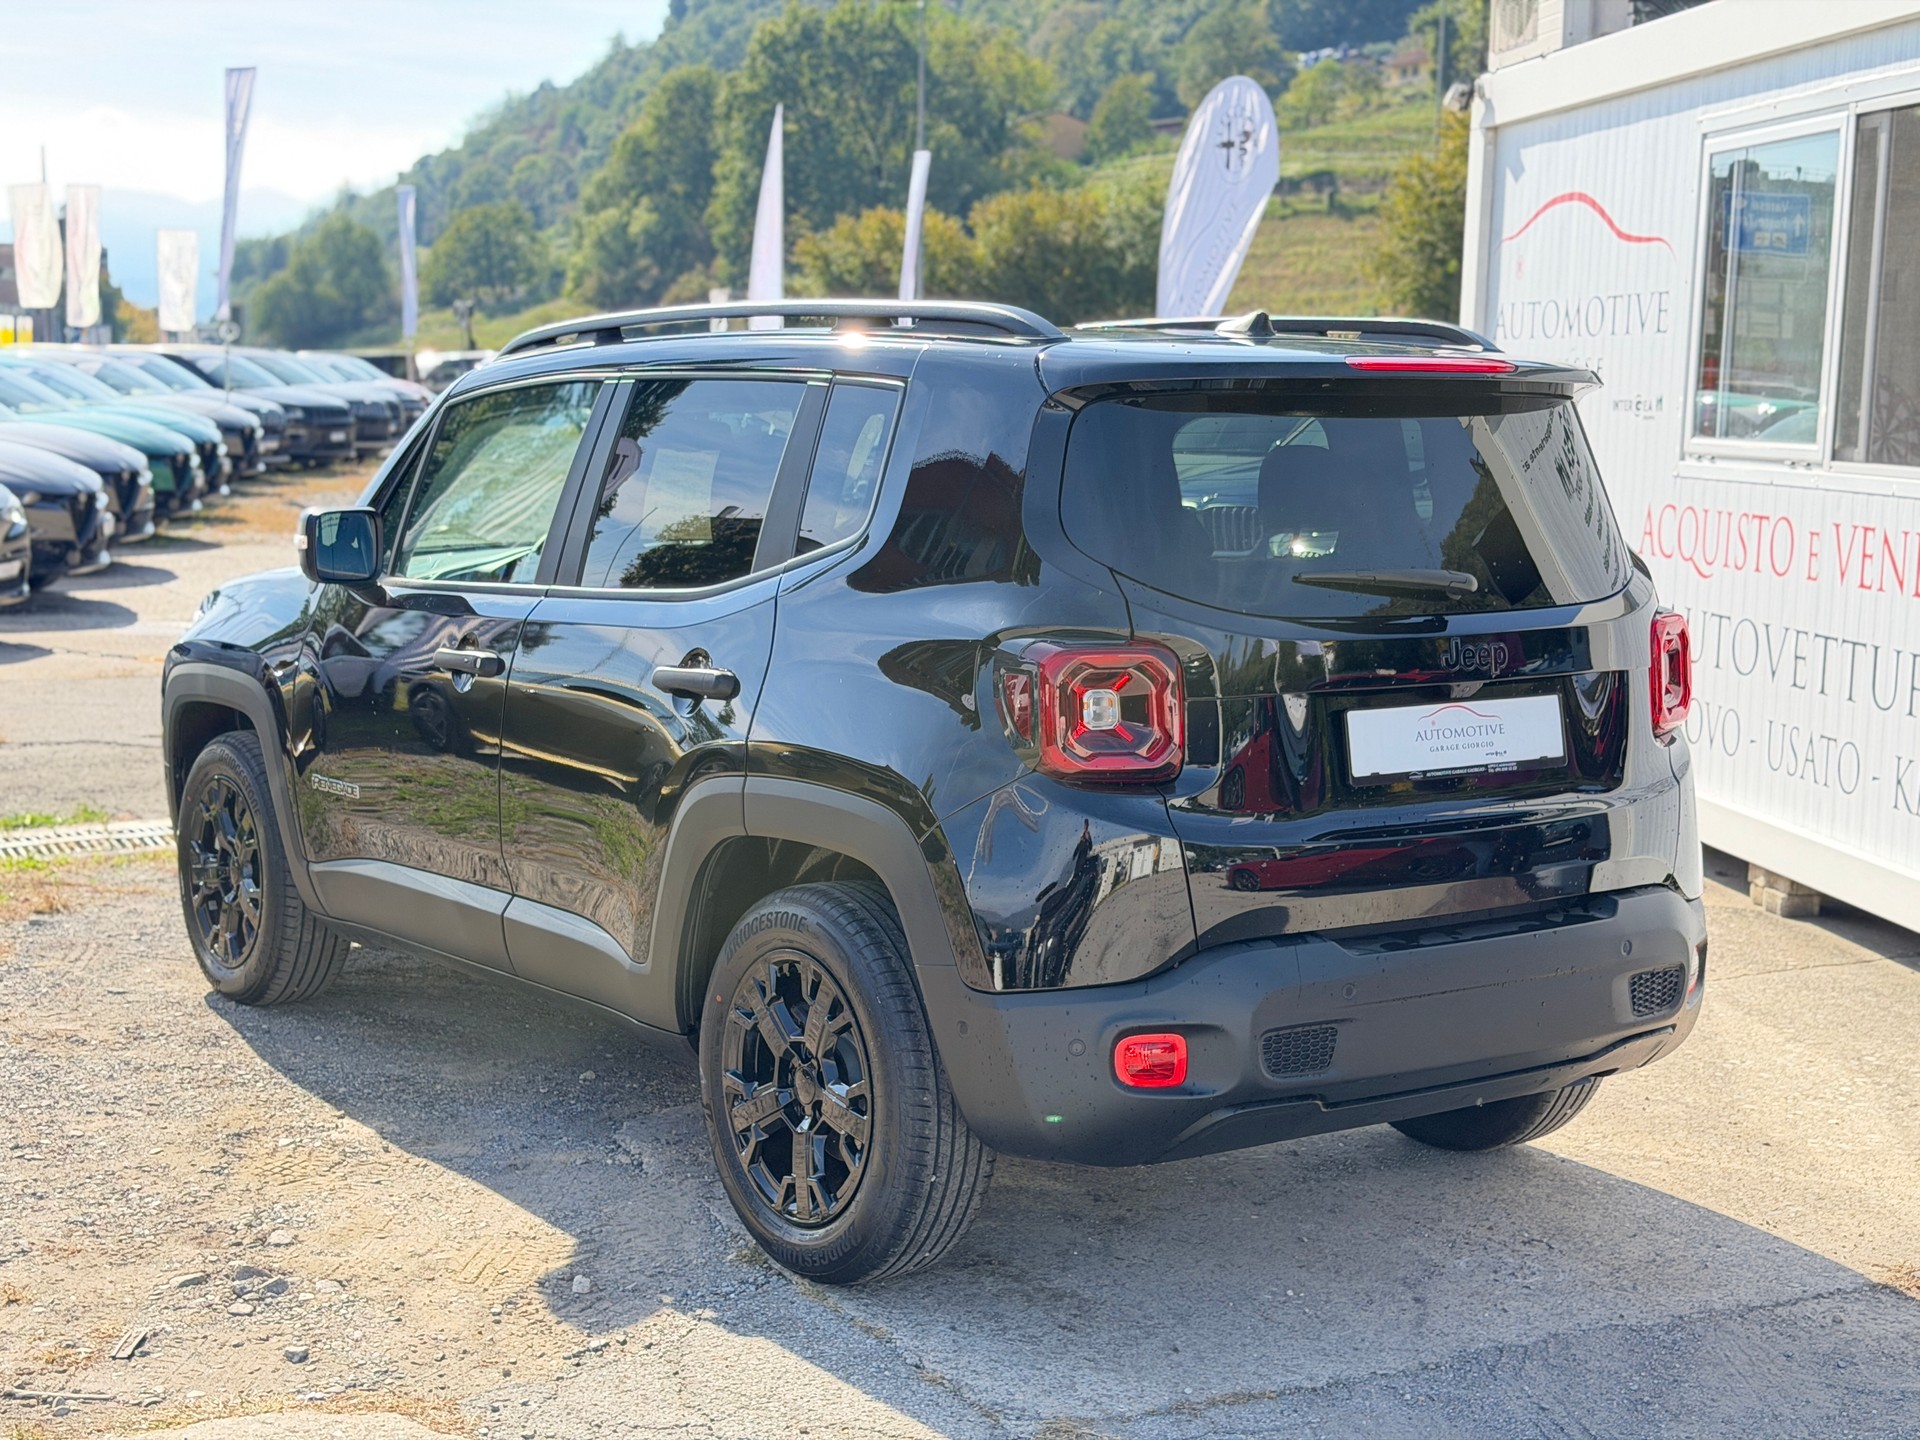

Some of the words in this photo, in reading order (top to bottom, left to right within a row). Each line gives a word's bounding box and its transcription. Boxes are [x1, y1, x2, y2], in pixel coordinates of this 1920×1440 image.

[1494, 291, 1670, 341] AUTOMOTIVE
[1638, 503, 1795, 579] ACQUISTO
[1806, 531, 1820, 582] E
[1441, 636, 1509, 675] Jeep
[1415, 723, 1505, 743] AUTOMOTIVE
[1429, 743, 1460, 753] GARAGE
[1461, 741, 1494, 751] GIORGIO
[311, 773, 360, 799] RENEGADE
[1767, 719, 1860, 795] USATO
[1892, 755, 1920, 817] K
[724, 910, 808, 966] BRIDGESTONE
